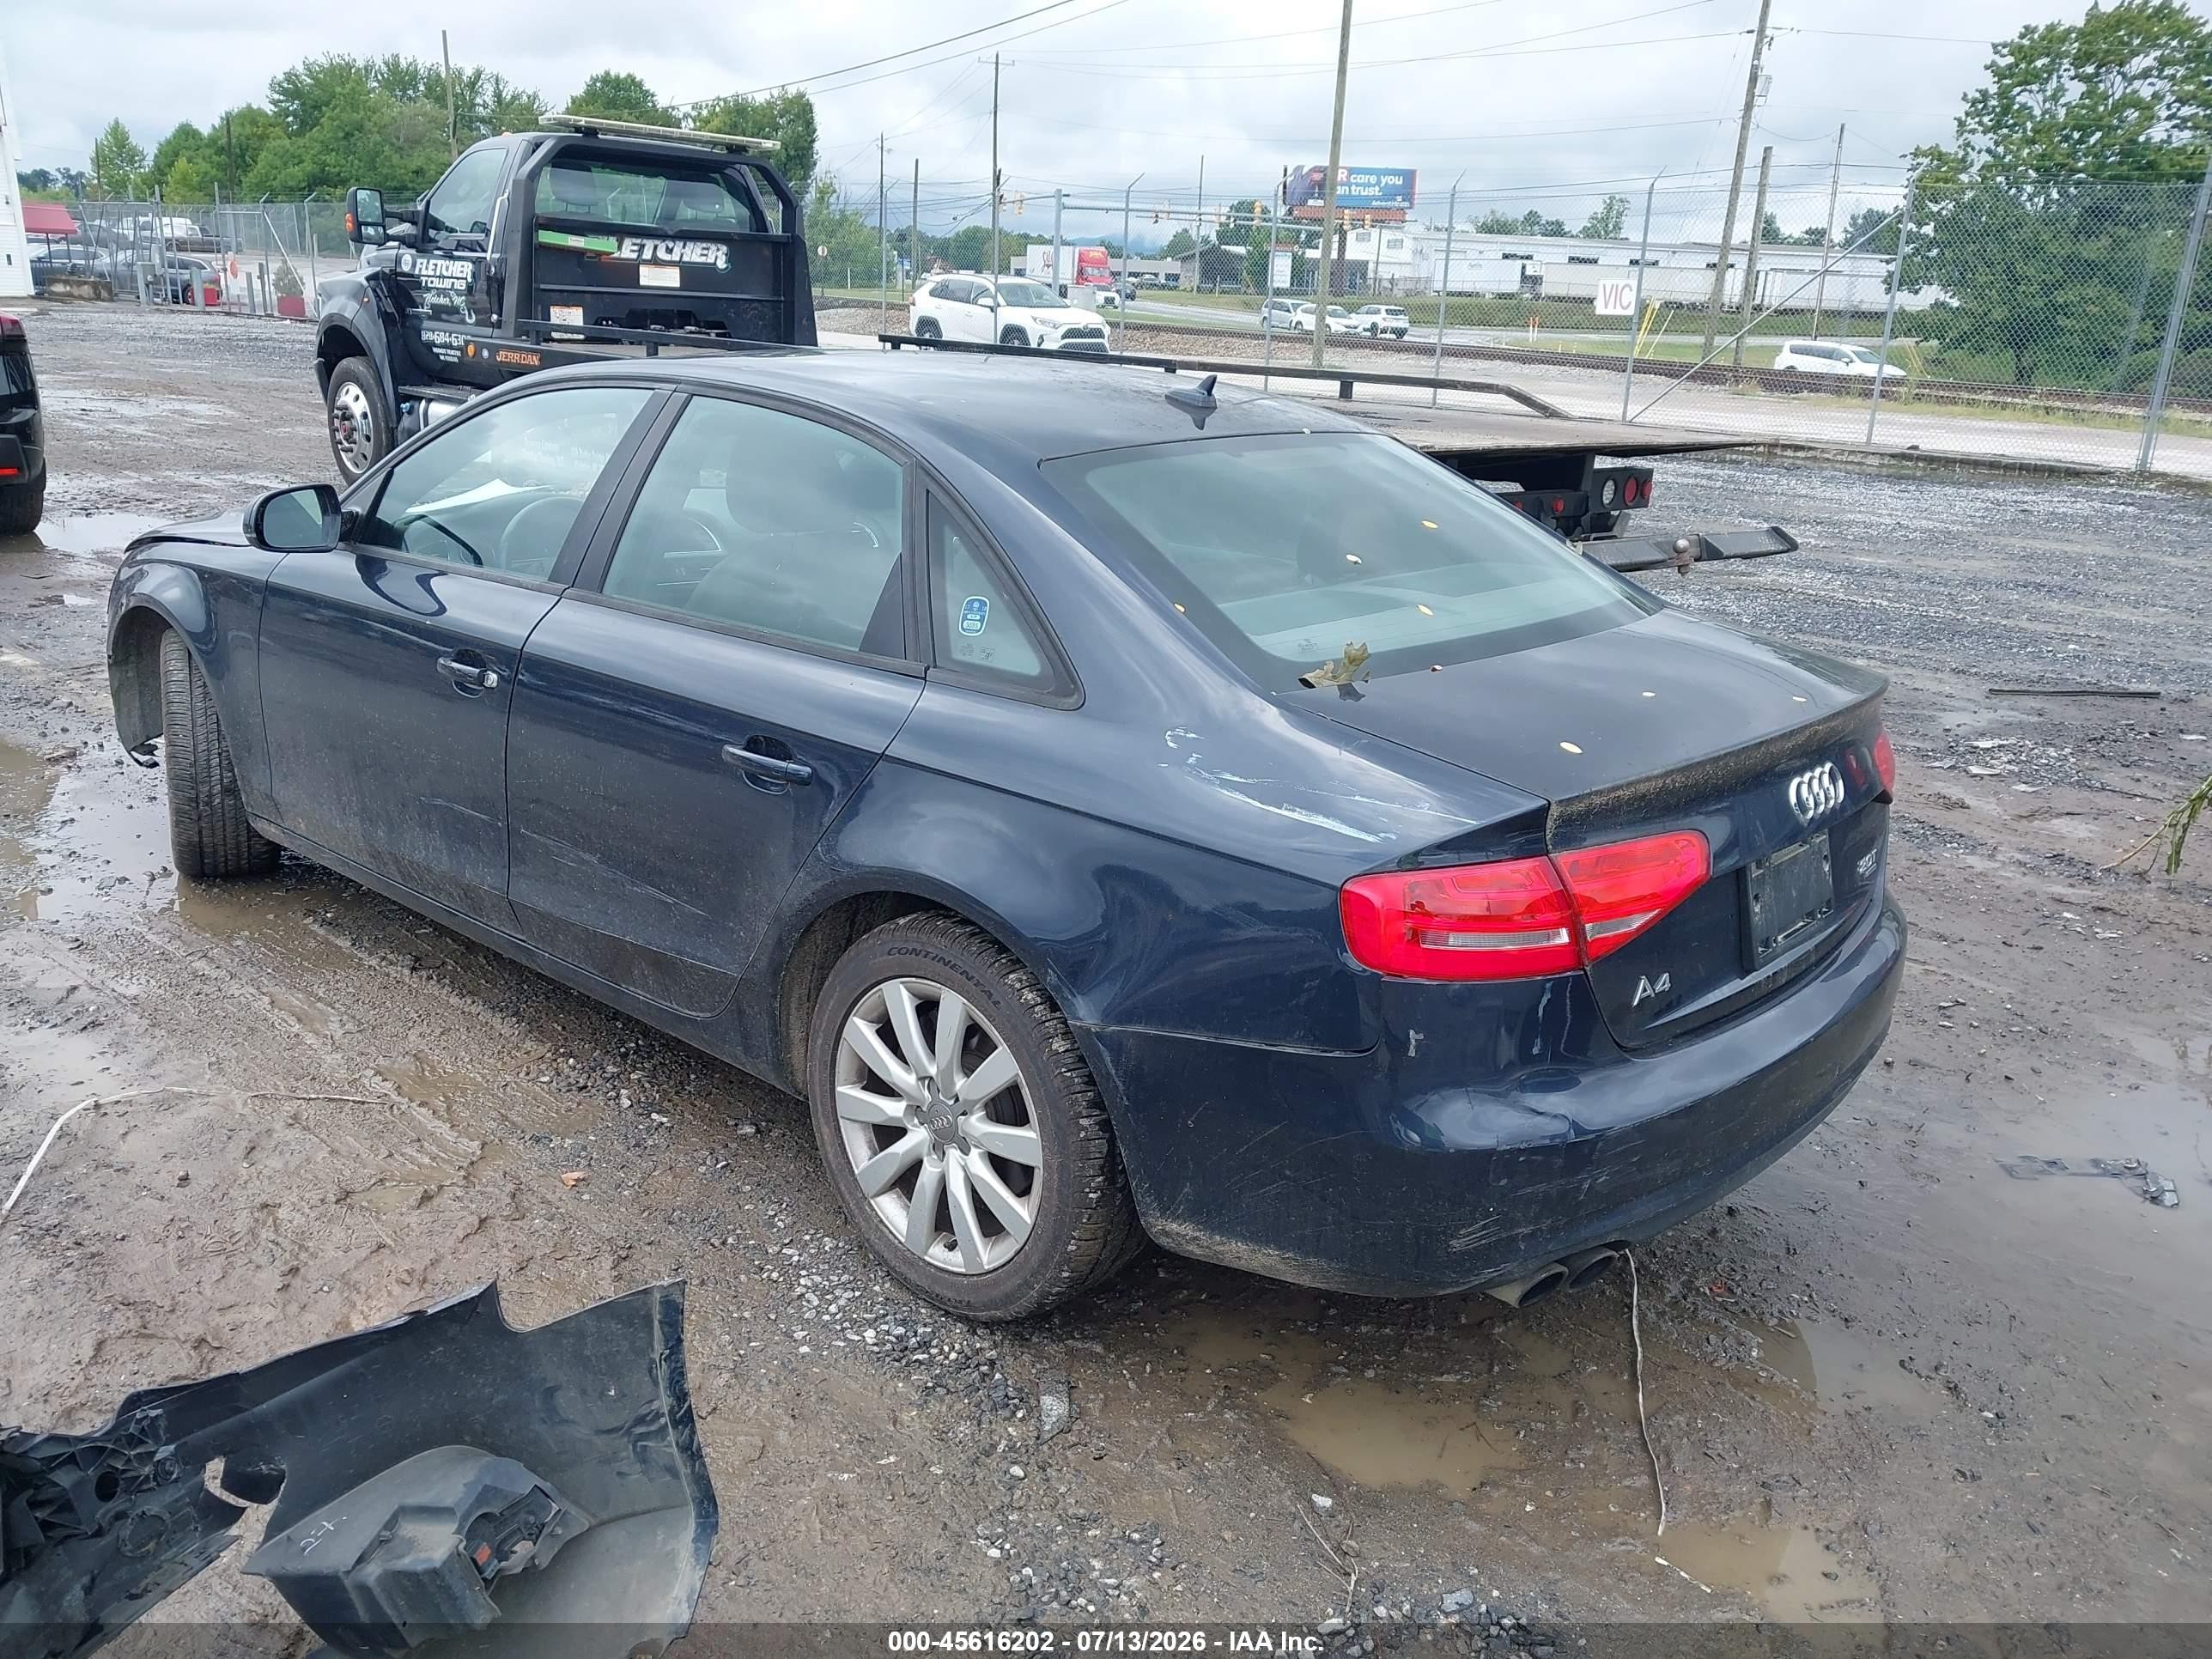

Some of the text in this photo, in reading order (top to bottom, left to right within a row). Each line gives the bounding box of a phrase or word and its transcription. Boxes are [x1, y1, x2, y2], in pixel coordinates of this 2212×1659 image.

[1350, 173, 1377, 184] care
[1380, 174, 1403, 186] you
[1351, 184, 1382, 196] trust.
[415, 258, 473, 283] FLETCHER
[420, 276, 466, 289] TOWING
[1602, 283, 1633, 310] VIC
[887, 946, 1002, 1011] CONTINENTAL
[1632, 972, 1671, 1008] A4
